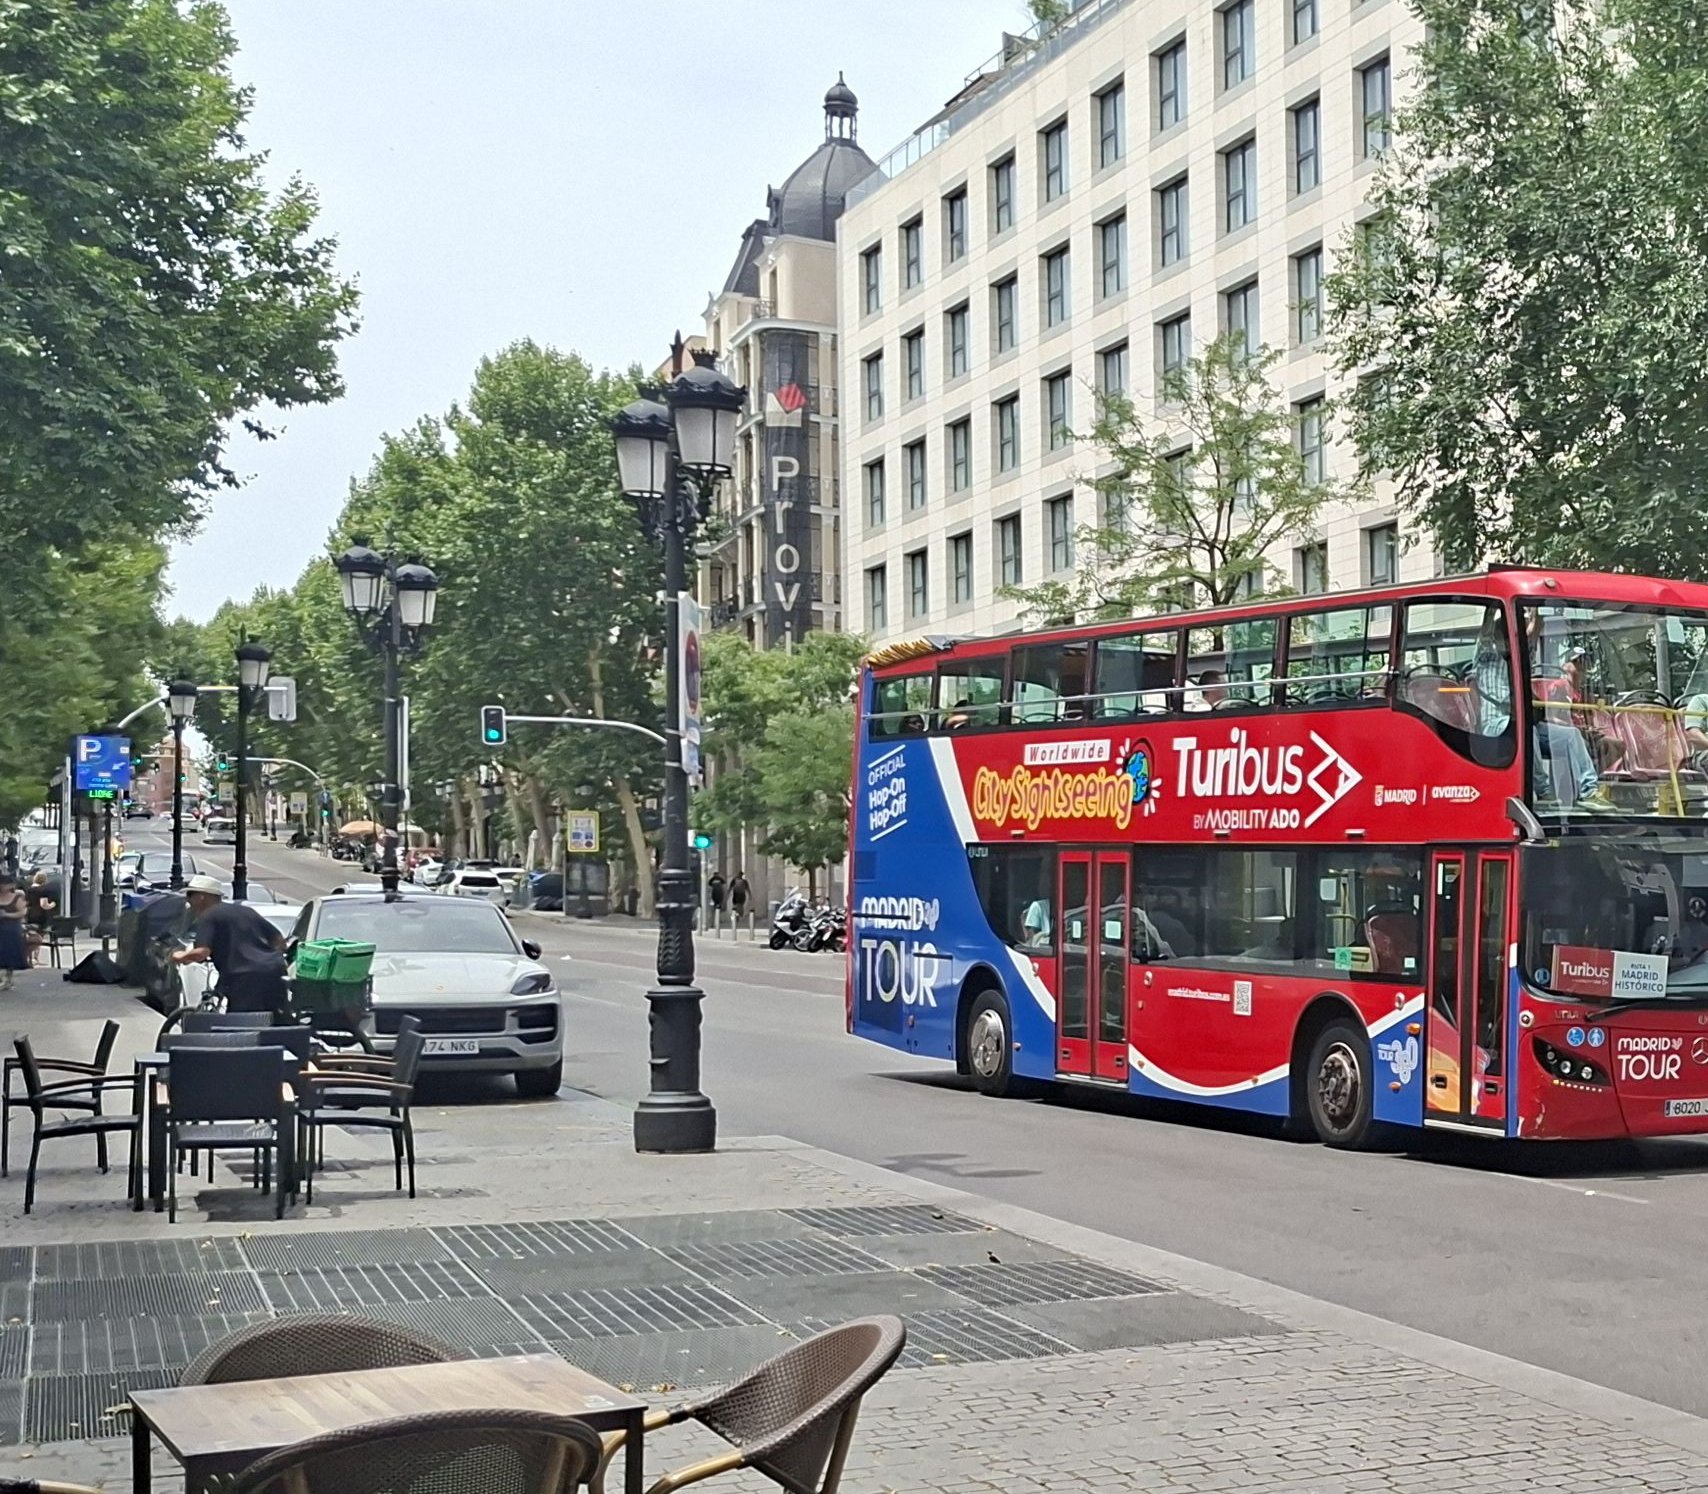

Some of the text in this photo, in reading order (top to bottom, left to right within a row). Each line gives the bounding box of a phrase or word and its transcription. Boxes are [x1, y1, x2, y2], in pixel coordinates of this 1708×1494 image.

[81, 739, 102, 761] P
[1029, 745, 1105, 762] Worldwide
[867, 754, 907, 786] OFFICIAL
[1172, 727, 1304, 797] Turibus
[868, 777, 906, 810] Hop-On
[1384, 789, 1417, 805] MADRID
[1431, 785, 1471, 798] avanza
[869, 797, 908, 831] Hop-Off
[1193, 808, 1300, 829] BY MOBILITY ADO
[861, 896, 924, 931] MADRID
[861, 938, 938, 1007] TOUR
[1560, 961, 1610, 978] Turibus
[1621, 969, 1659, 980] MADRID
[1615, 979, 1664, 992] HISTÓRICO
[450, 1040, 475, 1052] NKG
[1618, 1037, 1670, 1051] MADRID
[1617, 1055, 1681, 1080] TOUR
[1673, 1104, 1700, 1115] 8020
